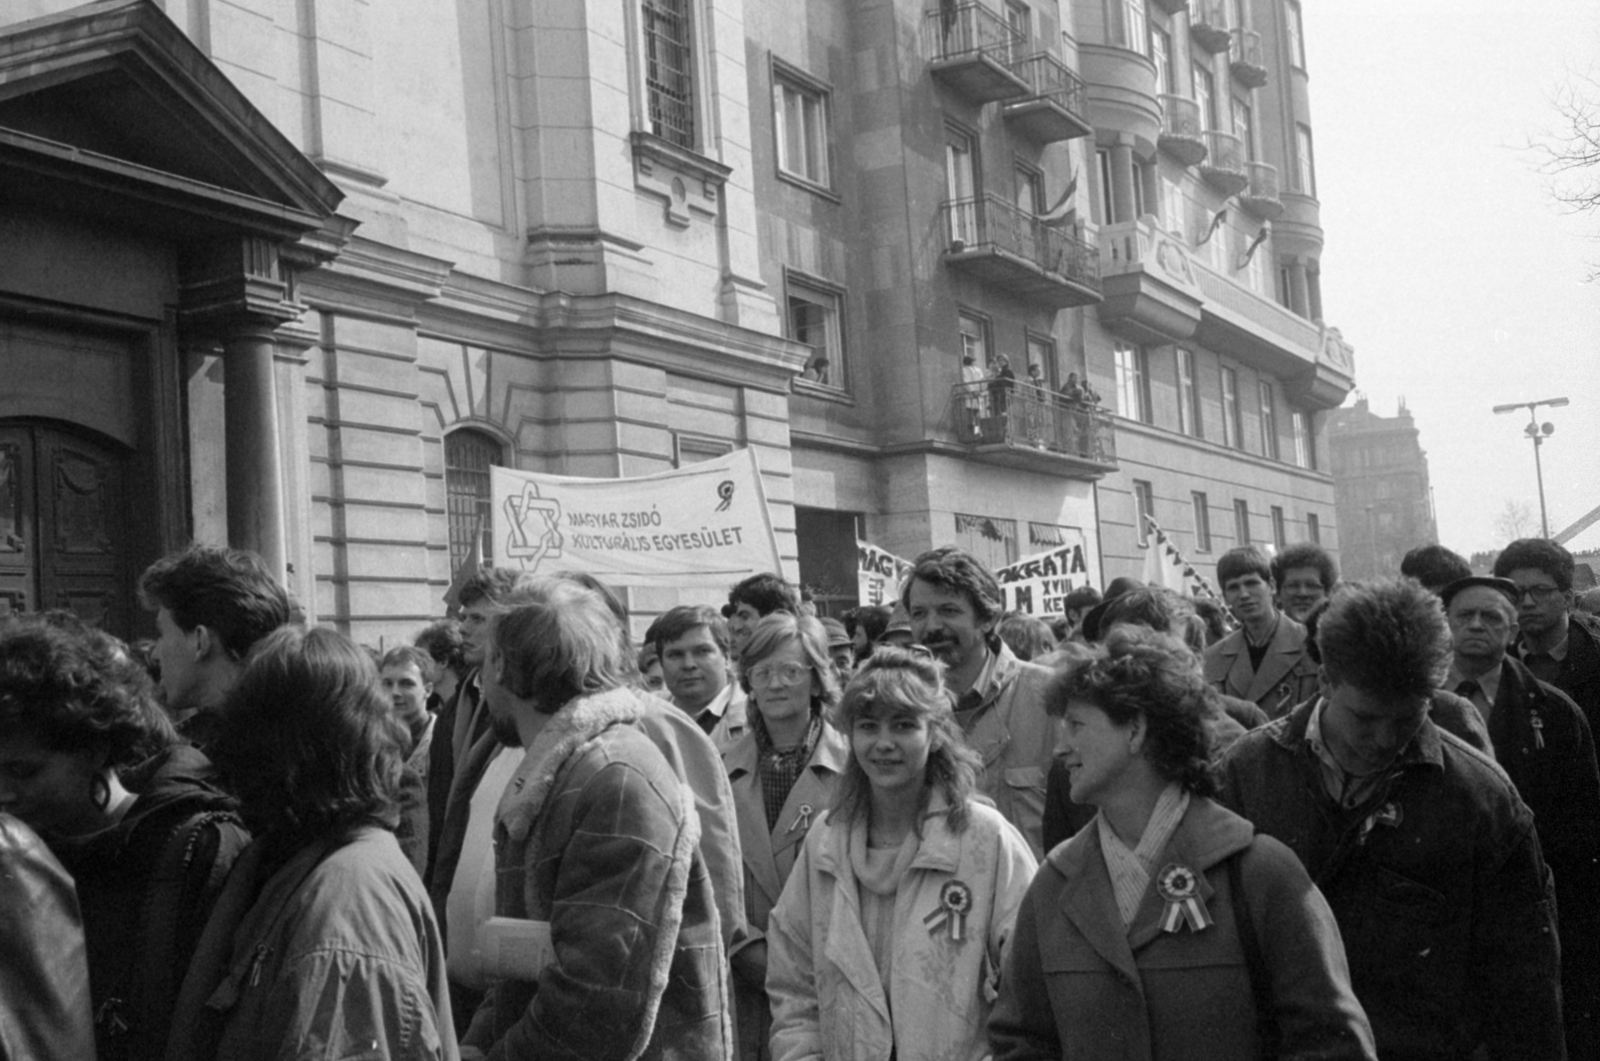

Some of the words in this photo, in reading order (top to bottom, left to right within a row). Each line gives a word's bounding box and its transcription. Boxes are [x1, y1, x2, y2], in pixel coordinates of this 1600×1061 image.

[567, 511, 618, 528] MAGYAR
[621, 503, 662, 528] ZSIDÓ
[572, 531, 651, 552] KULTURÁLIS
[653, 526, 742, 551] EGYESÜLET
[1043, 597, 1066, 613] KE
